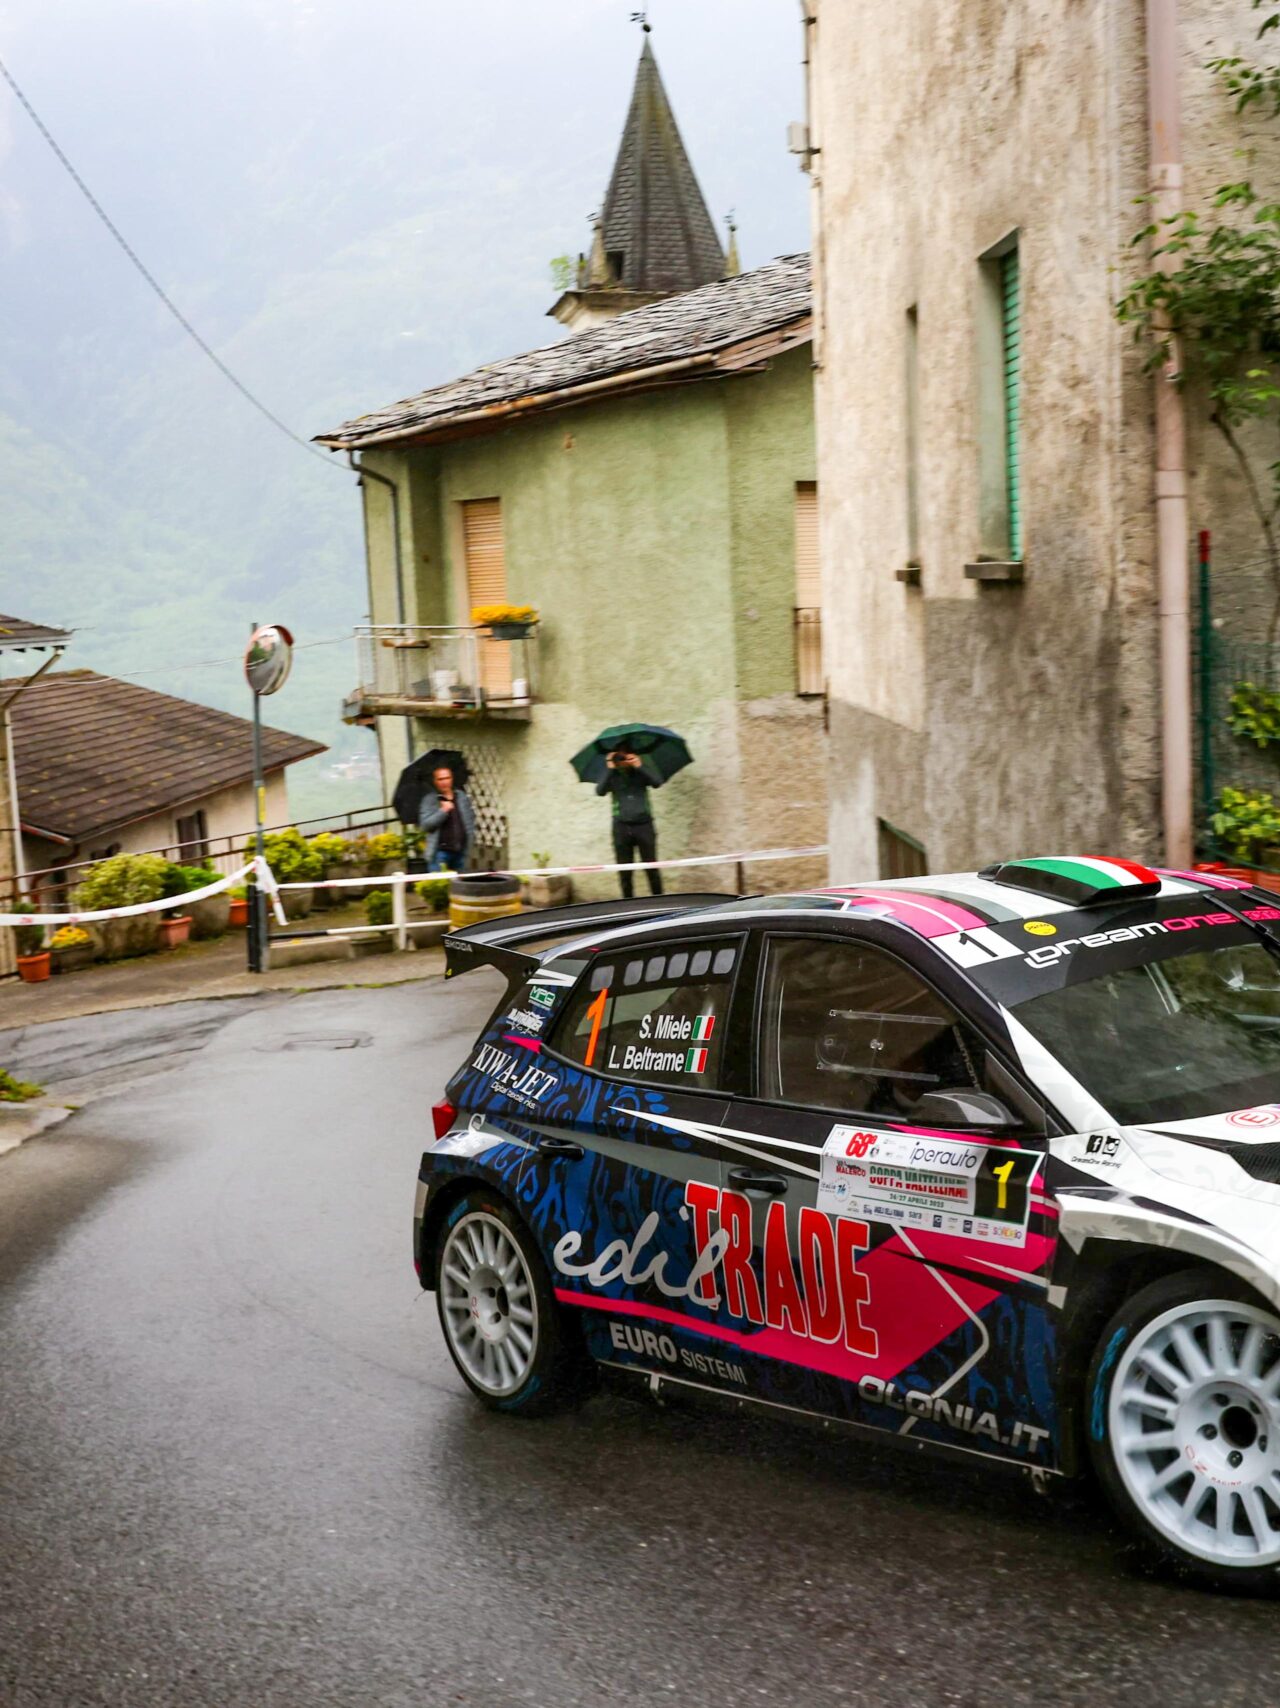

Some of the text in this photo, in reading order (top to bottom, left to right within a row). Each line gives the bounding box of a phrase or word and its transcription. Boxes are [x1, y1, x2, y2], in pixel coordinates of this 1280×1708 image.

[958, 932, 1000, 958] 1
[585, 988, 609, 1067] 1
[639, 1014, 692, 1040] S. Miele
[471, 1043, 558, 1100] KIWA-JET
[608, 1045, 685, 1072] L. Beltrame
[910, 1141, 978, 1169] iperauto
[993, 1160, 1015, 1209] 1
[684, 1180, 879, 1358] TRADE
[609, 1322, 748, 1384] EURO SISTEMI
